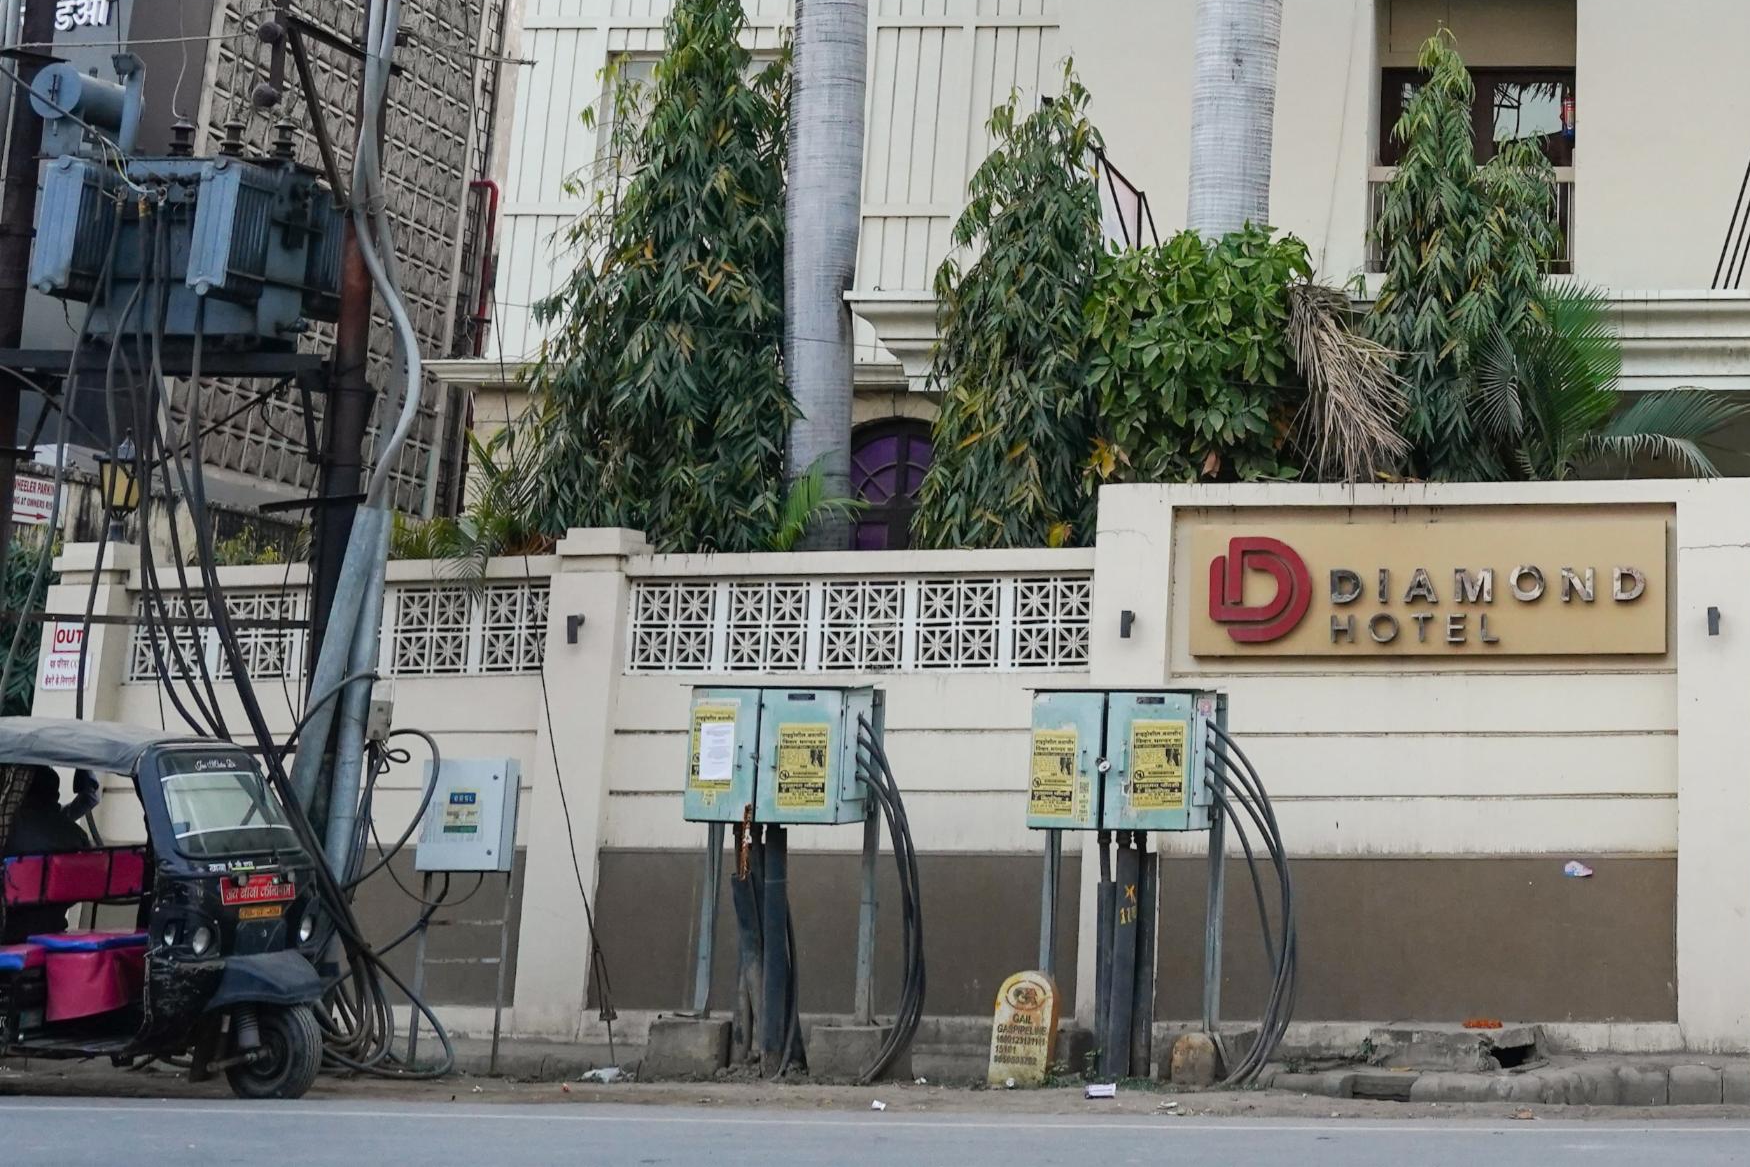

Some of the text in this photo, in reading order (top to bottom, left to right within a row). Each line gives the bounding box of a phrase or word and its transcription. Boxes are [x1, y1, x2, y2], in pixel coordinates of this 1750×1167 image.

[37, 482, 55, 496] PARKIN
[45, 500, 53, 510] RIS
[1329, 564, 1648, 605] DIAMOND
[1329, 612, 1500, 643] HOTEL
[57, 629, 84, 644] OUT
[1012, 1013, 1032, 1024] GAIL
